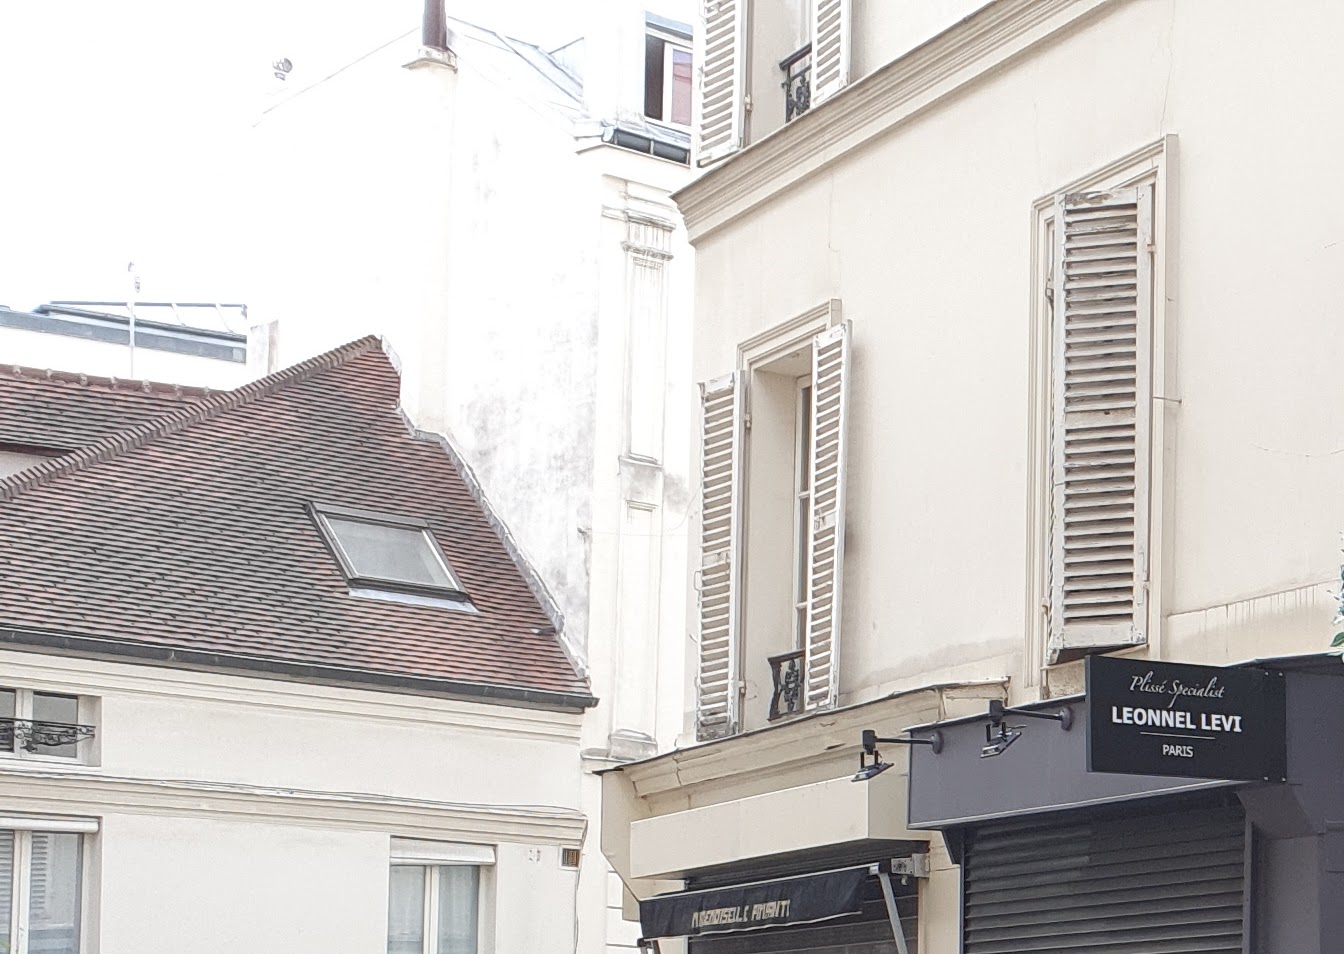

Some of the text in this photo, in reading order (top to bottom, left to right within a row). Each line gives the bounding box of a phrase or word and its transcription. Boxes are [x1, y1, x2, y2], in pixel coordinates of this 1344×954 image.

[1129, 670, 1225, 708] Plissé Specialist
[1112, 705, 1243, 733] LEONNEL LEVI
[1162, 744, 1194, 758] PARIS
